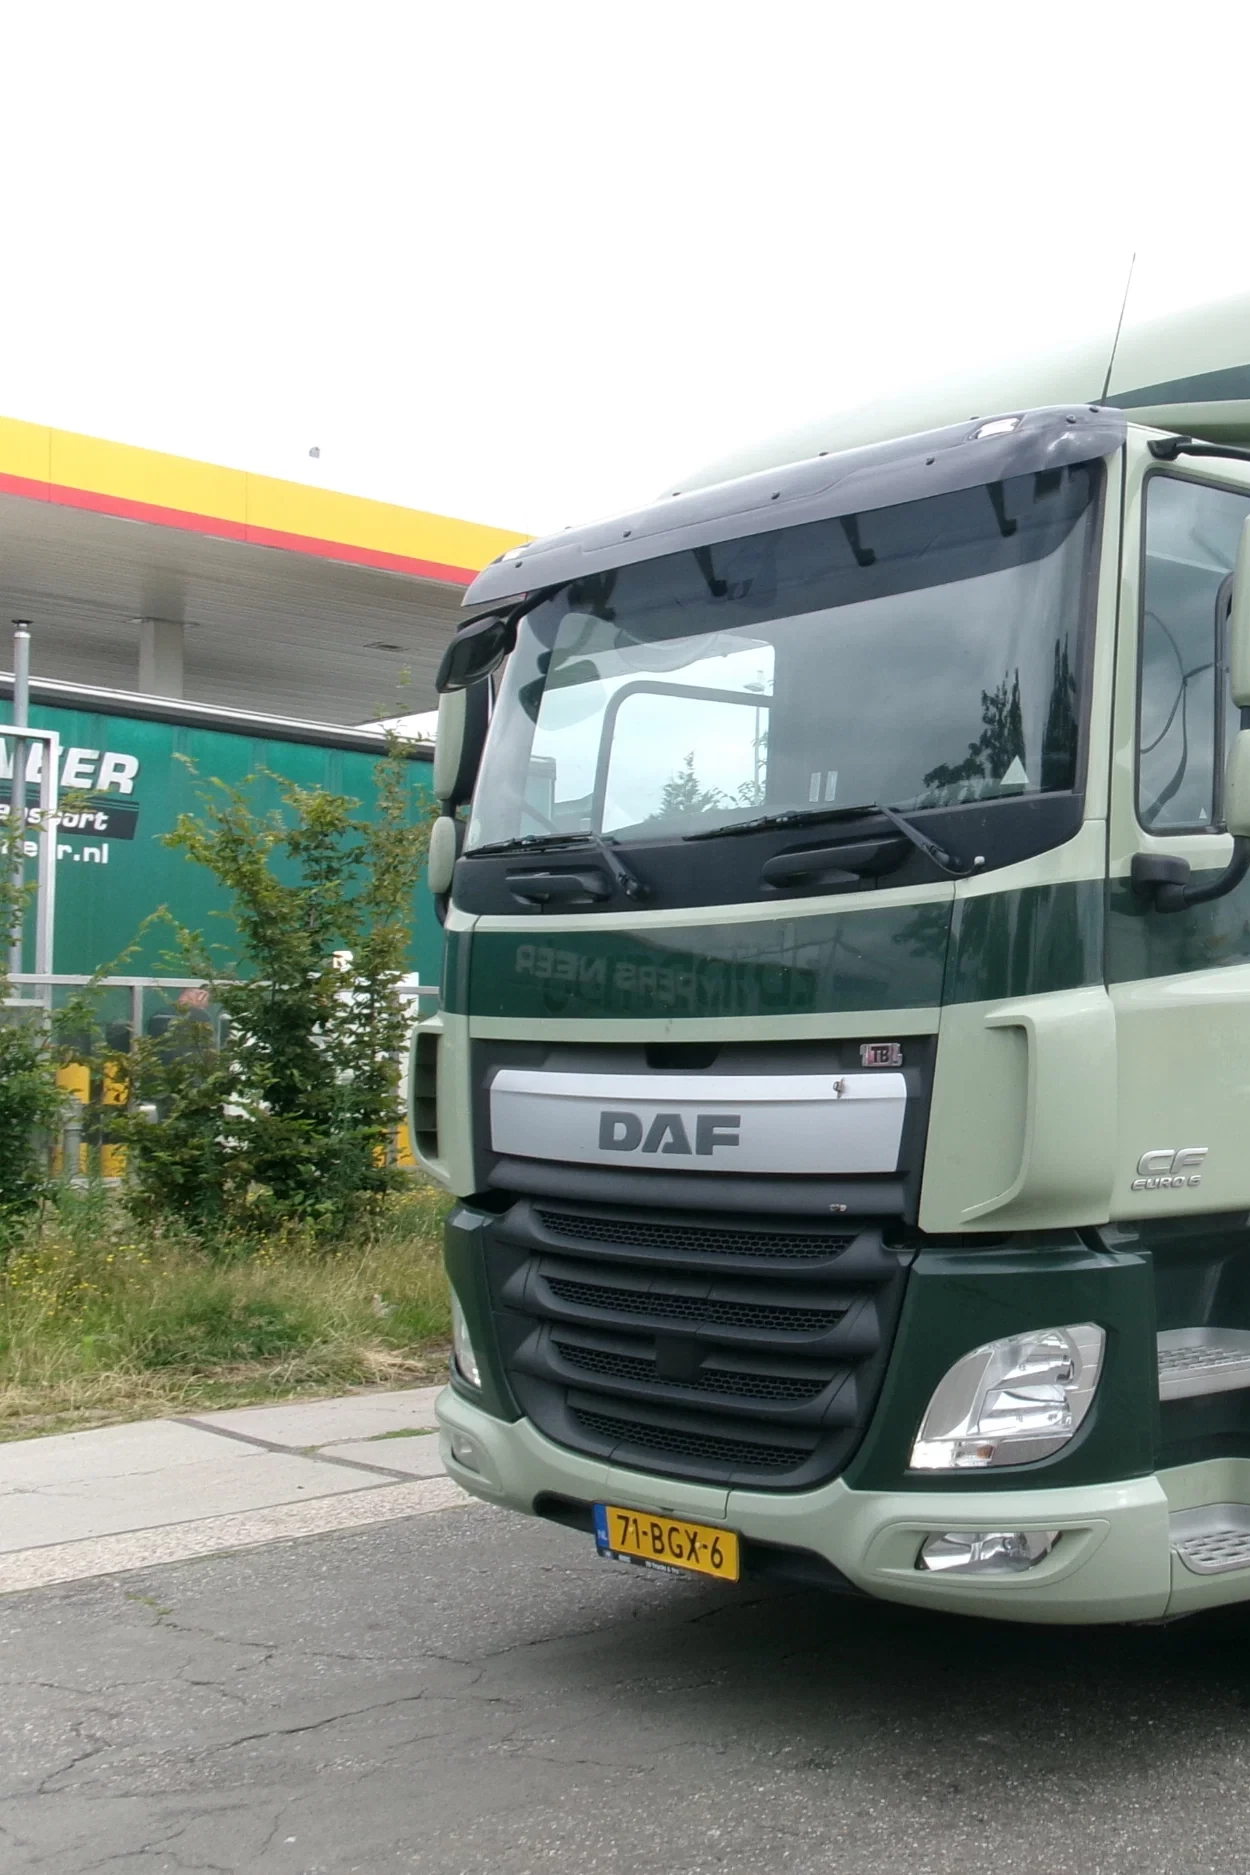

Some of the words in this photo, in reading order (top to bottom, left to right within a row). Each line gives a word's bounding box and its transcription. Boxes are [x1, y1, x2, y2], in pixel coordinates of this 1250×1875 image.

[871, 1046, 889, 1063] TB
[598, 1111, 741, 1155] DAF
[1137, 1147, 1208, 1175] CF
[1131, 1177, 1185, 1191] EURO
[1187, 1175, 1201, 1187] 6
[616, 1514, 723, 1569] 71-BGX-6
